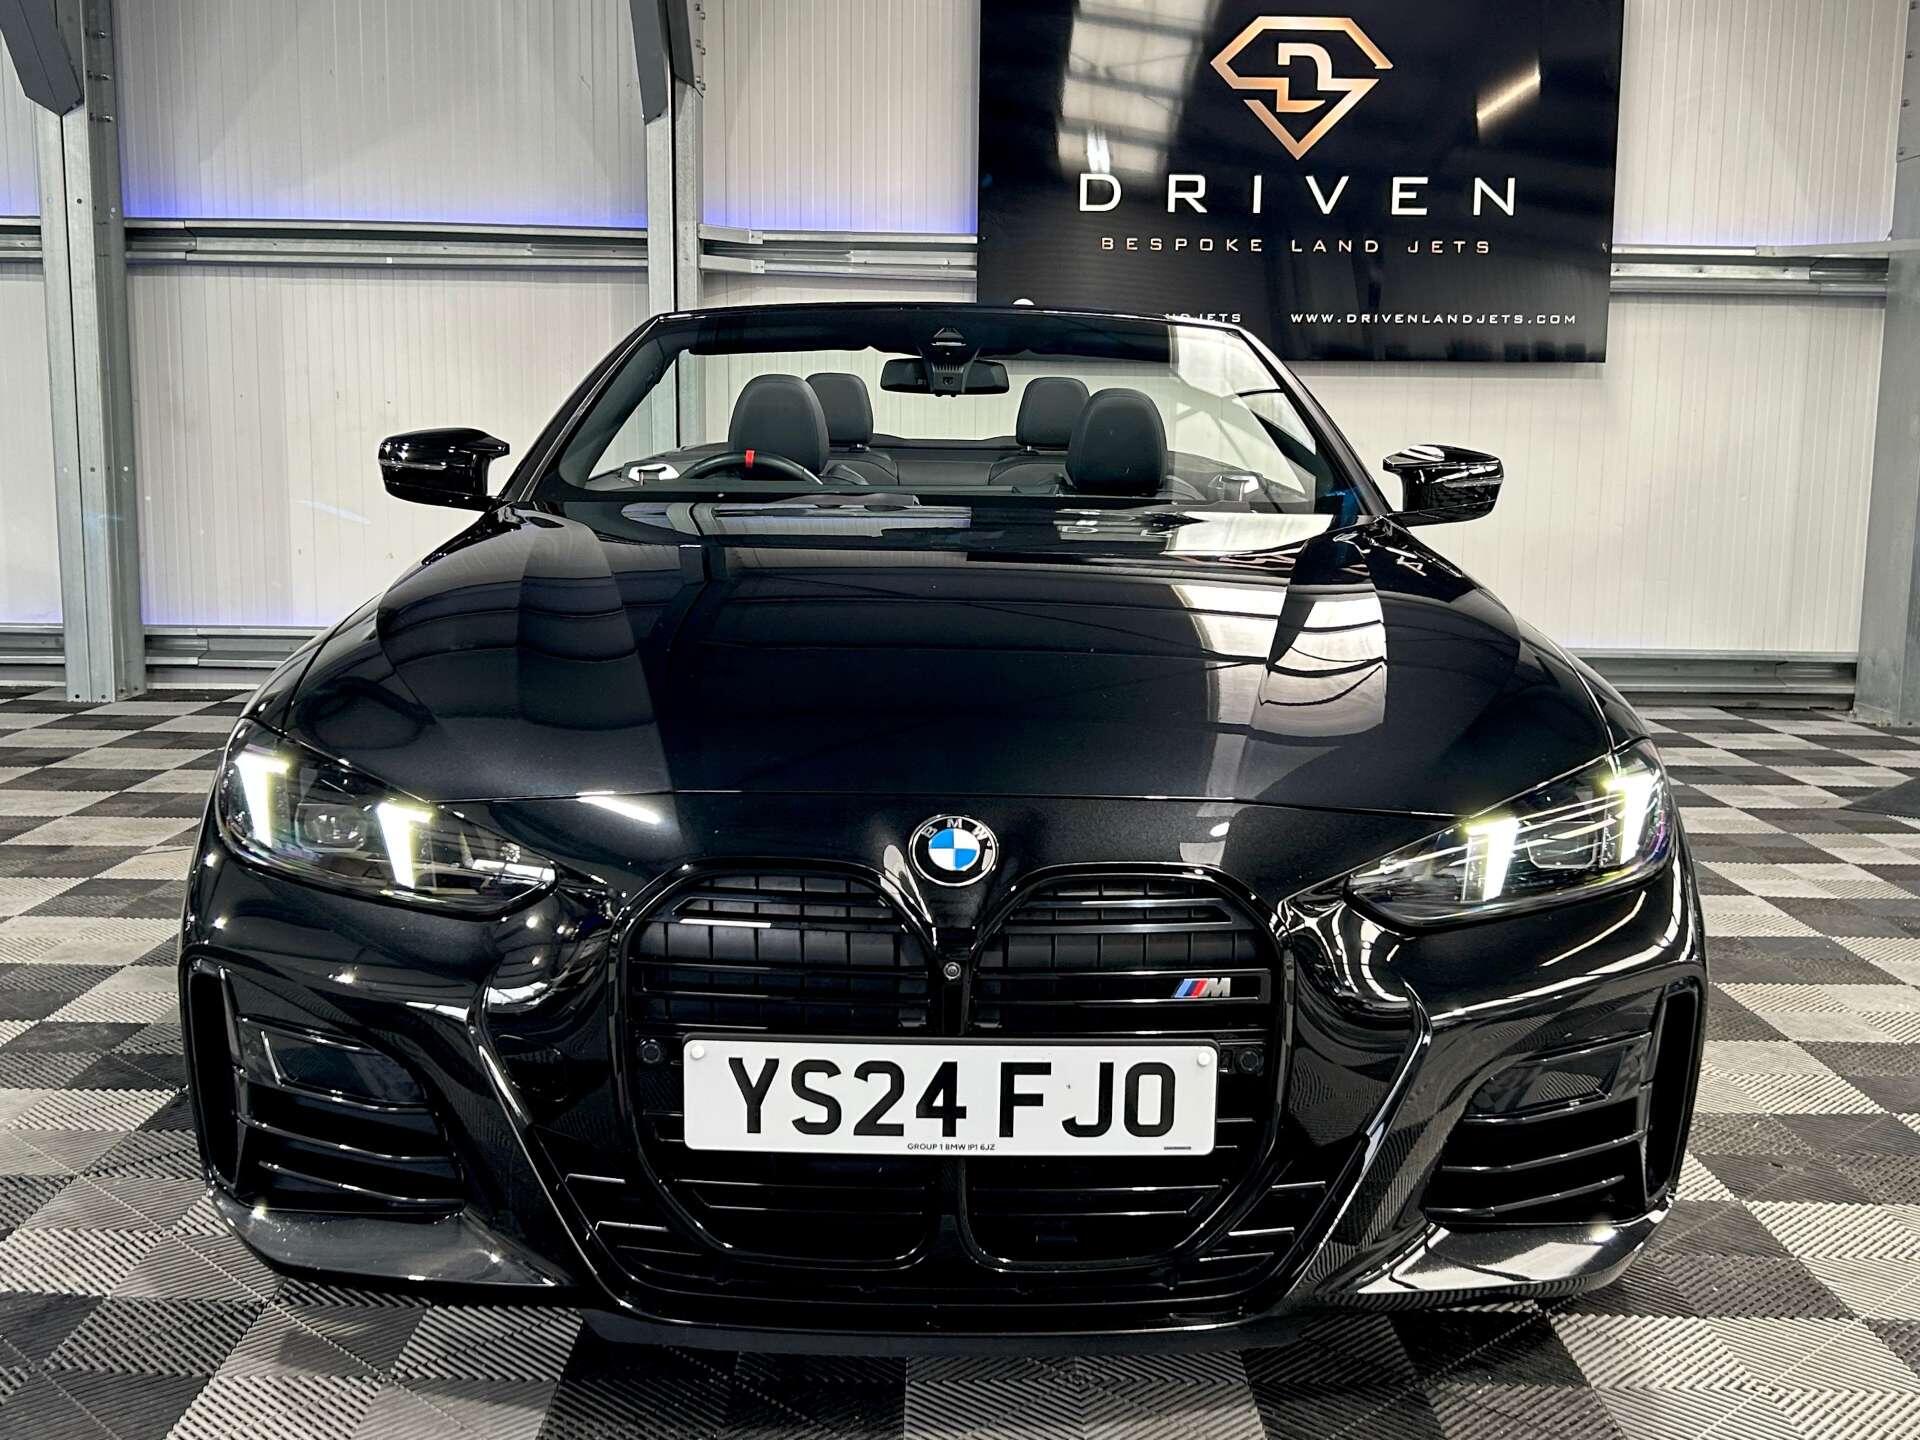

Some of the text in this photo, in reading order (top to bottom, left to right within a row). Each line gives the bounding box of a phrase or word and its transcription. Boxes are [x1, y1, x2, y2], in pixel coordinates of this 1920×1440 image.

[1079, 173, 1516, 216] DRIVEN
[1101, 237, 1490, 254] BESPOKE LAND JETS
[1290, 313, 1577, 325] WWW.DRIVENLANDJETS.COM
[920, 818, 988, 841] BMW
[728, 1057, 967, 1137] YS24
[945, 1143, 966, 1151] BMW
